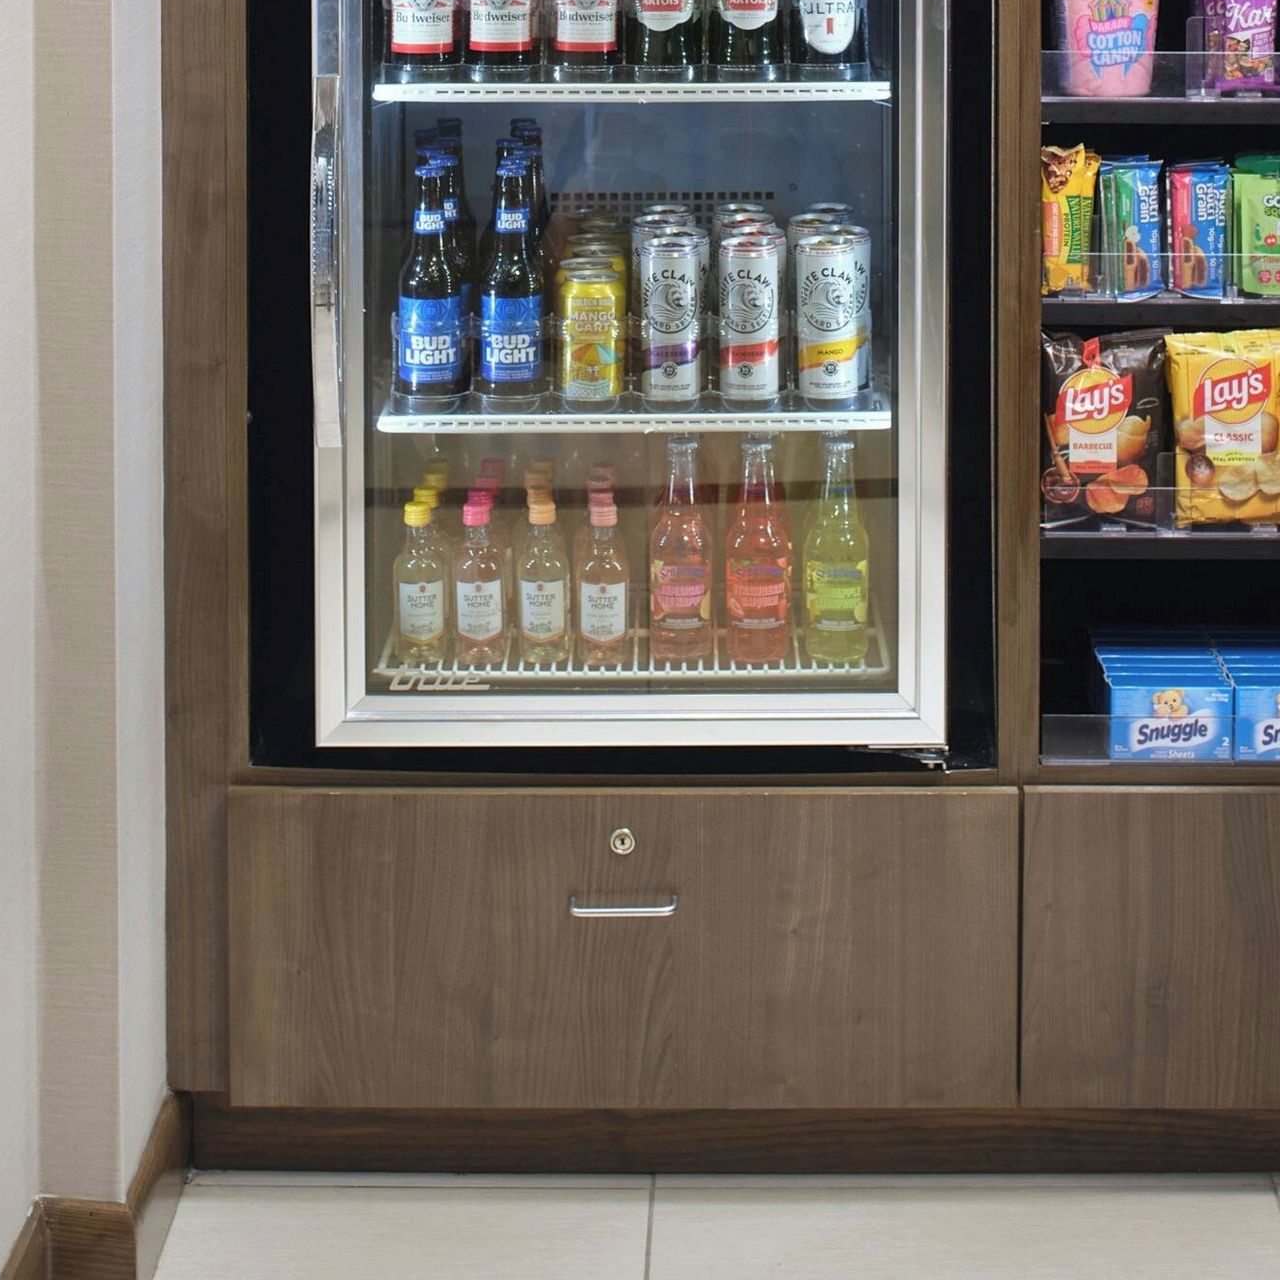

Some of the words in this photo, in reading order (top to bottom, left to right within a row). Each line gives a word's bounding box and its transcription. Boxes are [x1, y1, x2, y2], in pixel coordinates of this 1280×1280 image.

[472, 10, 527, 22] Budweiser
[560, 10, 614, 22] Budweiser
[1087, 31, 1142, 49] COTTON
[1091, 47, 1139, 65] CANDY
[1138, 185, 1150, 223] Grain
[1195, 183, 1207, 221] Grain
[420, 213, 441, 222] BUD
[497, 219, 526, 230] LIGHT
[500, 213, 523, 222] BUD
[416, 220, 444, 231] LIGHT
[737, 269, 772, 288] CLAW
[821, 267, 852, 285] CLAW
[569, 311, 615, 321] MANGO
[575, 322, 609, 333] CART
[410, 334, 451, 350] BUD
[490, 334, 531, 349] BUD
[405, 348, 457, 366] LIGHT
[486, 347, 537, 365] LIGHT
[1203, 369, 1265, 413] Lay's
[1065, 378, 1126, 421] Lay's
[1213, 433, 1254, 442] CLASSIC
[1072, 442, 1114, 450] BARBECUE
[1137, 719, 1208, 745] Snuggle
[1221, 737, 1230, 746] 2
[1169, 749, 1195, 759] Sheets
